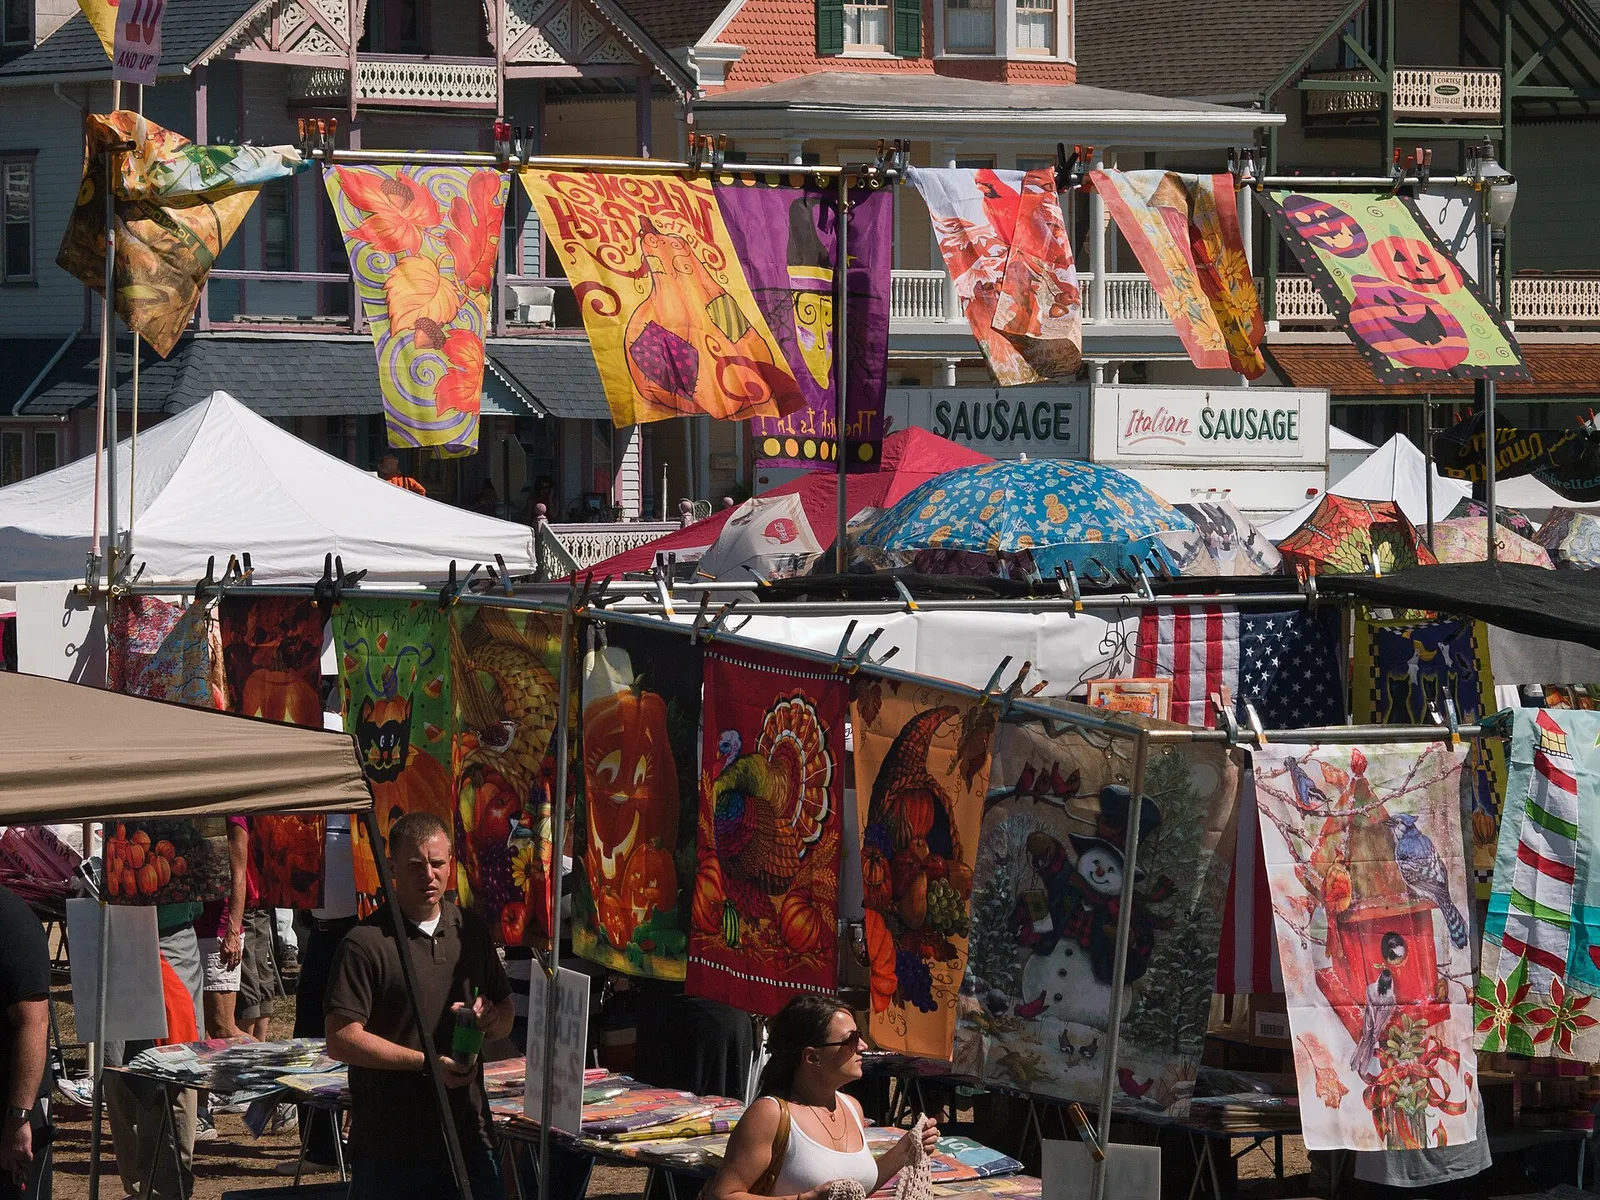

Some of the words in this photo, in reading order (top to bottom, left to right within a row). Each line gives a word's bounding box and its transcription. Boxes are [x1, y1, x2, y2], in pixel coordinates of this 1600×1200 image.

[117, 51, 138, 68] AND
[139, 54, 154, 70] UP
[933, 400, 1073, 441] SAUSAGE
[1124, 406, 1193, 438] Italian
[1199, 407, 1299, 441] SAUSAGE
